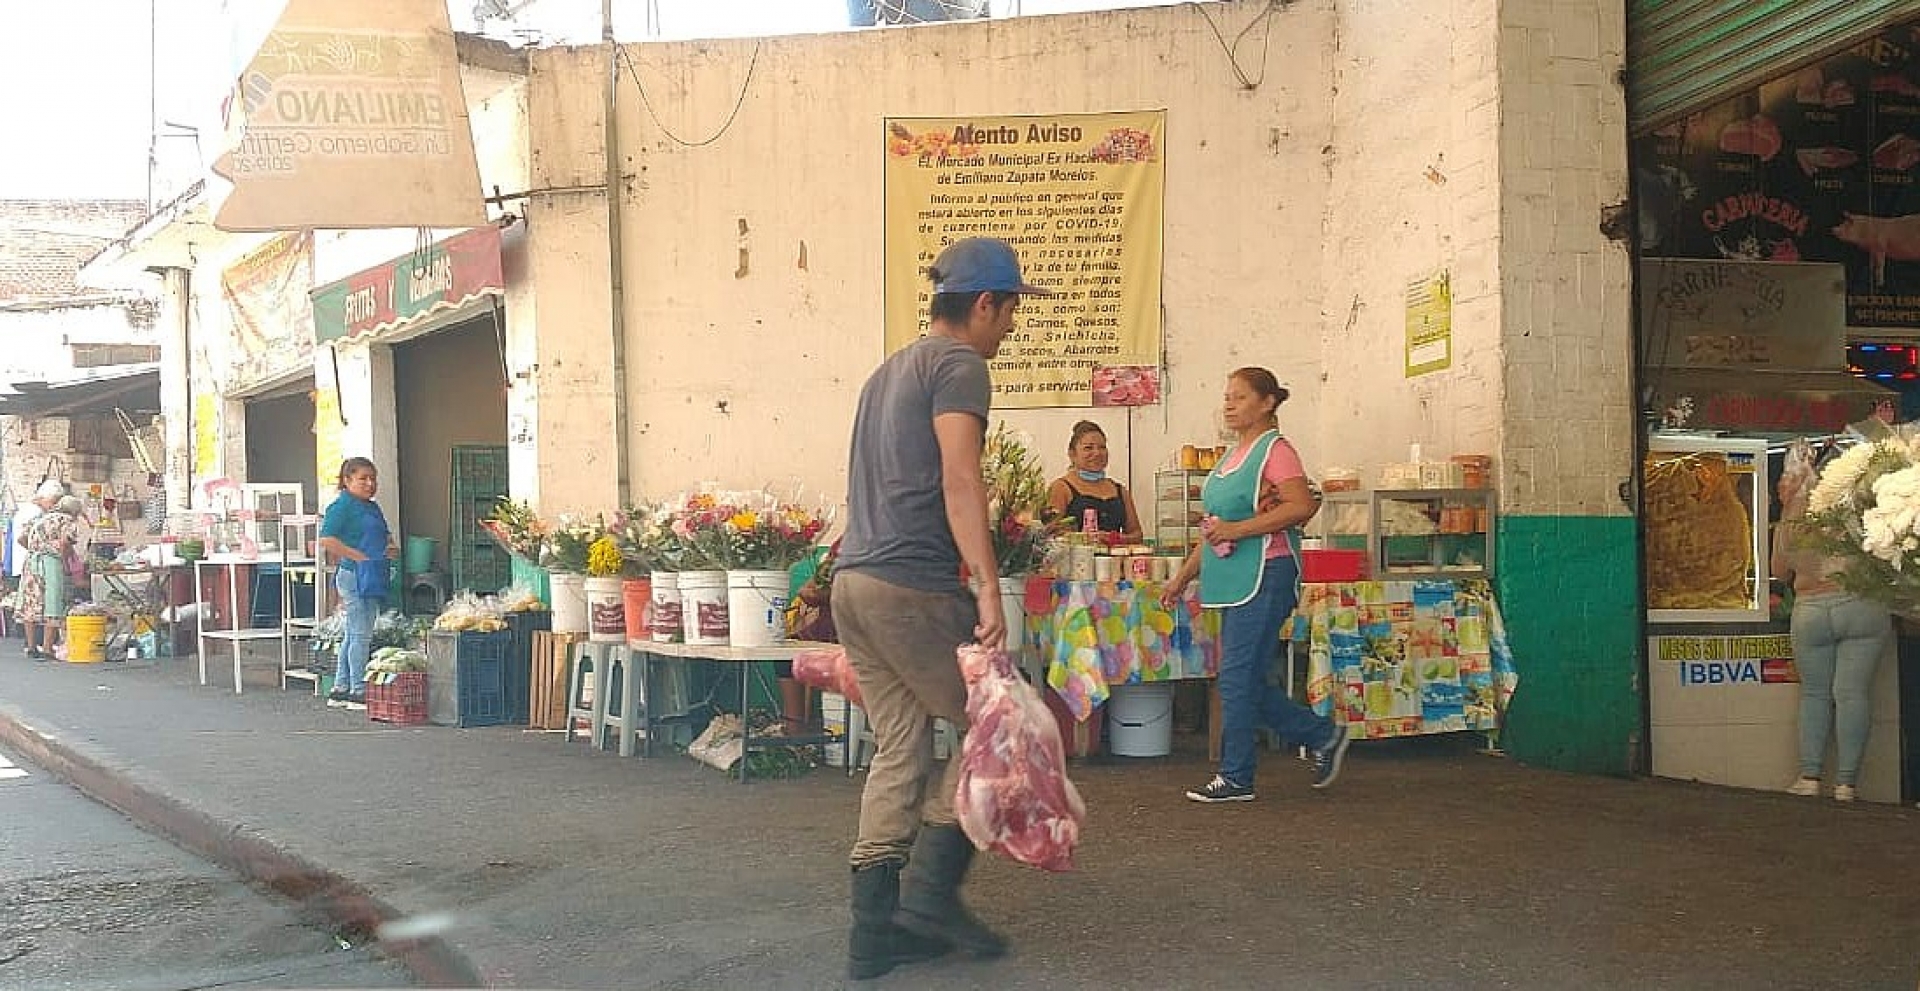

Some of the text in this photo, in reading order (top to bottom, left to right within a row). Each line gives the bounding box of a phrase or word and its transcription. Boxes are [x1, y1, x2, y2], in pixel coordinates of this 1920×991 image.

[953, 122, 1082, 145] Atento Aviso
[936, 154, 984, 168] Mercado
[988, 152, 1044, 168] Municipal
[937, 172, 951, 185] de
[954, 171, 1004, 185] Emiliano
[1006, 170, 1046, 186] Zapata
[1055, 191, 1098, 204] general
[956, 207, 996, 219] abierto
[999, 208, 1013, 218] en
[1016, 206, 1034, 217] los
[1037, 204, 1095, 220] siguientes
[918, 222, 934, 233] de
[943, 222, 1015, 233] cuarentena
[1024, 221, 1048, 234] por
[1051, 234, 1069, 246] las
[1074, 233, 1123, 245] medidas
[1039, 247, 1122, 260] necesarias
[1047, 262, 1062, 273] de
[1031, 276, 1121, 288] como siempre
[1070, 291, 1086, 300] en
[1089, 288, 1121, 299] todos
[1053, 304, 1086, 315] como
[1063, 344, 1120, 356] Abarrotes
[990, 359, 1033, 371] comida
[1037, 359, 1067, 370] entre
[1004, 384, 1034, 395] para
[1730, 637, 1793, 659] INTERESE
[1690, 662, 1758, 684] BBVA
